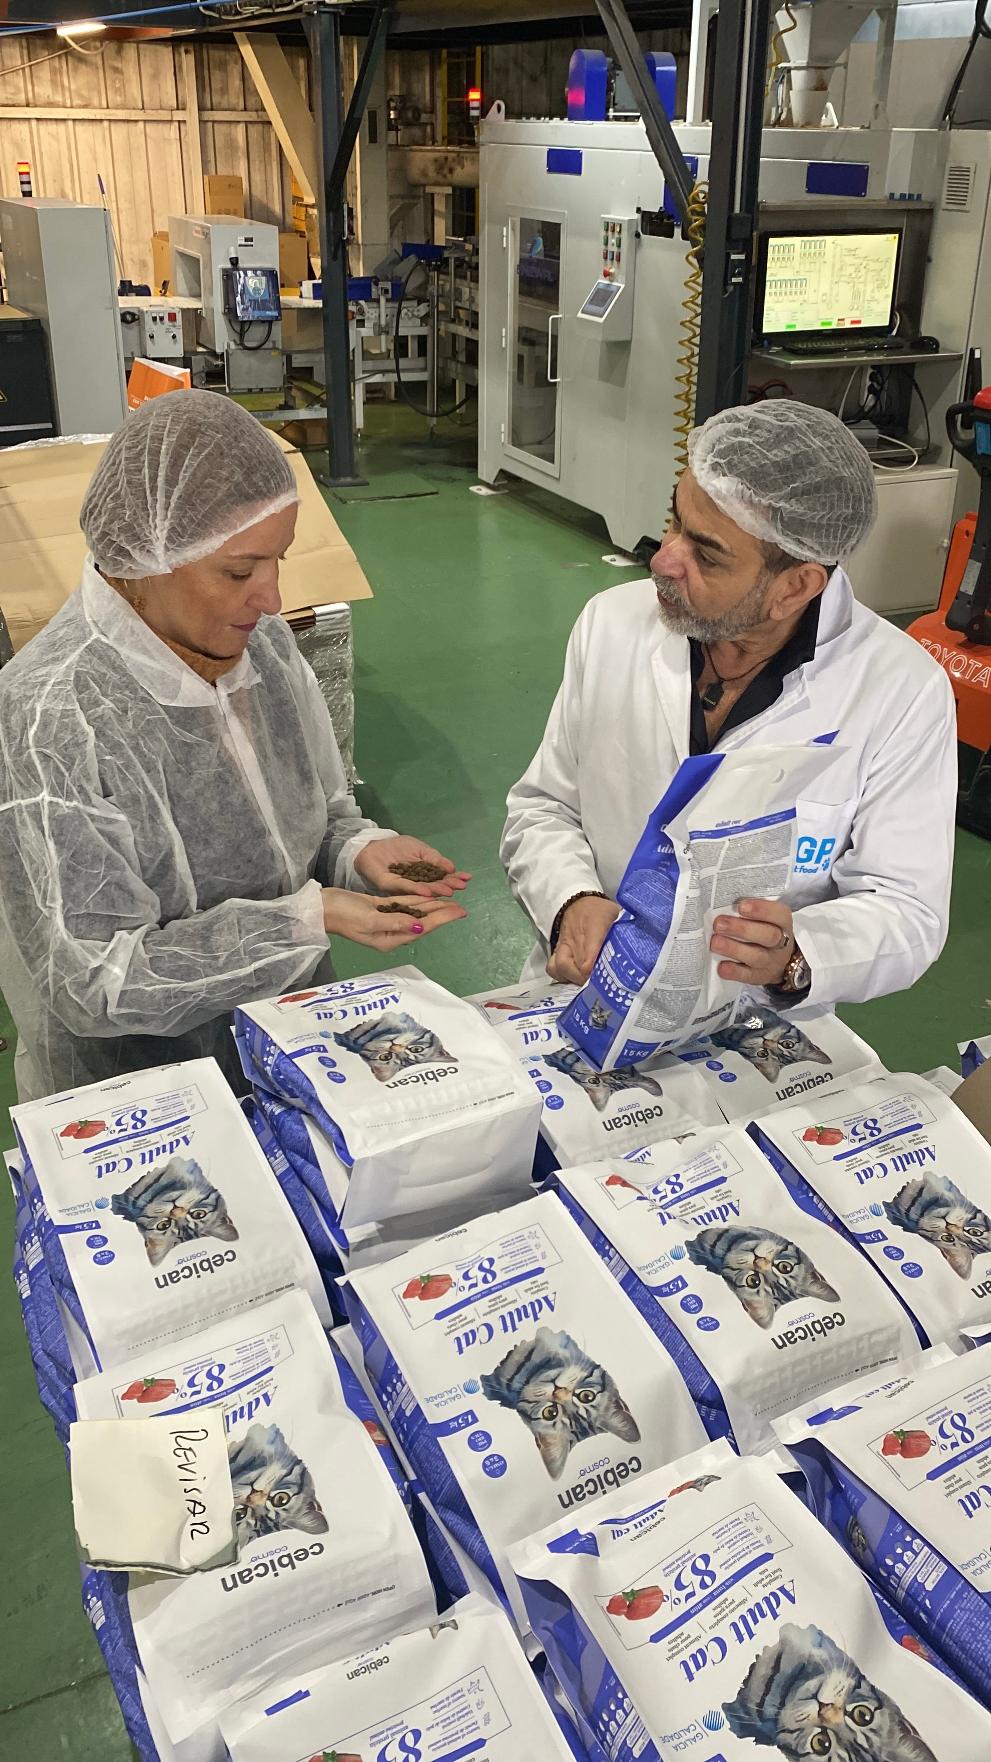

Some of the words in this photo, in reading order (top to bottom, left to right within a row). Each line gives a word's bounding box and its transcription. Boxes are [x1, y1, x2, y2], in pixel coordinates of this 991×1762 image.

[920, 638, 991, 688] TOYOTA
[315, 1009, 348, 1021] Cat
[353, 991, 401, 1018] Adult
[522, 1028, 552, 1046] Cat
[385, 1066, 458, 1090] cebican
[602, 1105, 664, 1132] cebican
[139, 1130, 196, 1166] Adult
[889, 1145, 936, 1172] Adult
[96, 1157, 133, 1179] Cat
[853, 1162, 888, 1185] Cat
[154, 1249, 237, 1289] cebican
[176, 1249, 208, 1266] cosmo
[450, 1256, 497, 1296] 85%
[498, 1291, 557, 1334] Adult
[453, 1322, 494, 1356] Cat
[770, 1311, 846, 1351] cebican
[172, 1364, 226, 1402] 85%
[423, 1386, 459, 1404] CALIDADE
[225, 1385, 278, 1433] Adul
[434, 1392, 462, 1409] GALICIA
[457, 1414, 474, 1426] 1.5
[929, 1412, 975, 1455] 85%
[579, 1457, 611, 1478] cosmo
[557, 1456, 642, 1509] cebican
[220, 1542, 325, 1593] cebican
[250, 1545, 288, 1564] cosmo
[662, 1553, 717, 1611] 85%
[729, 1579, 797, 1644] Adult
[346, 1655, 391, 1681] cebican
[679, 1636, 728, 1683] Cat
[659, 1723, 697, 1744] CALIDADE
[672, 1732, 703, 1752] GALICIA
